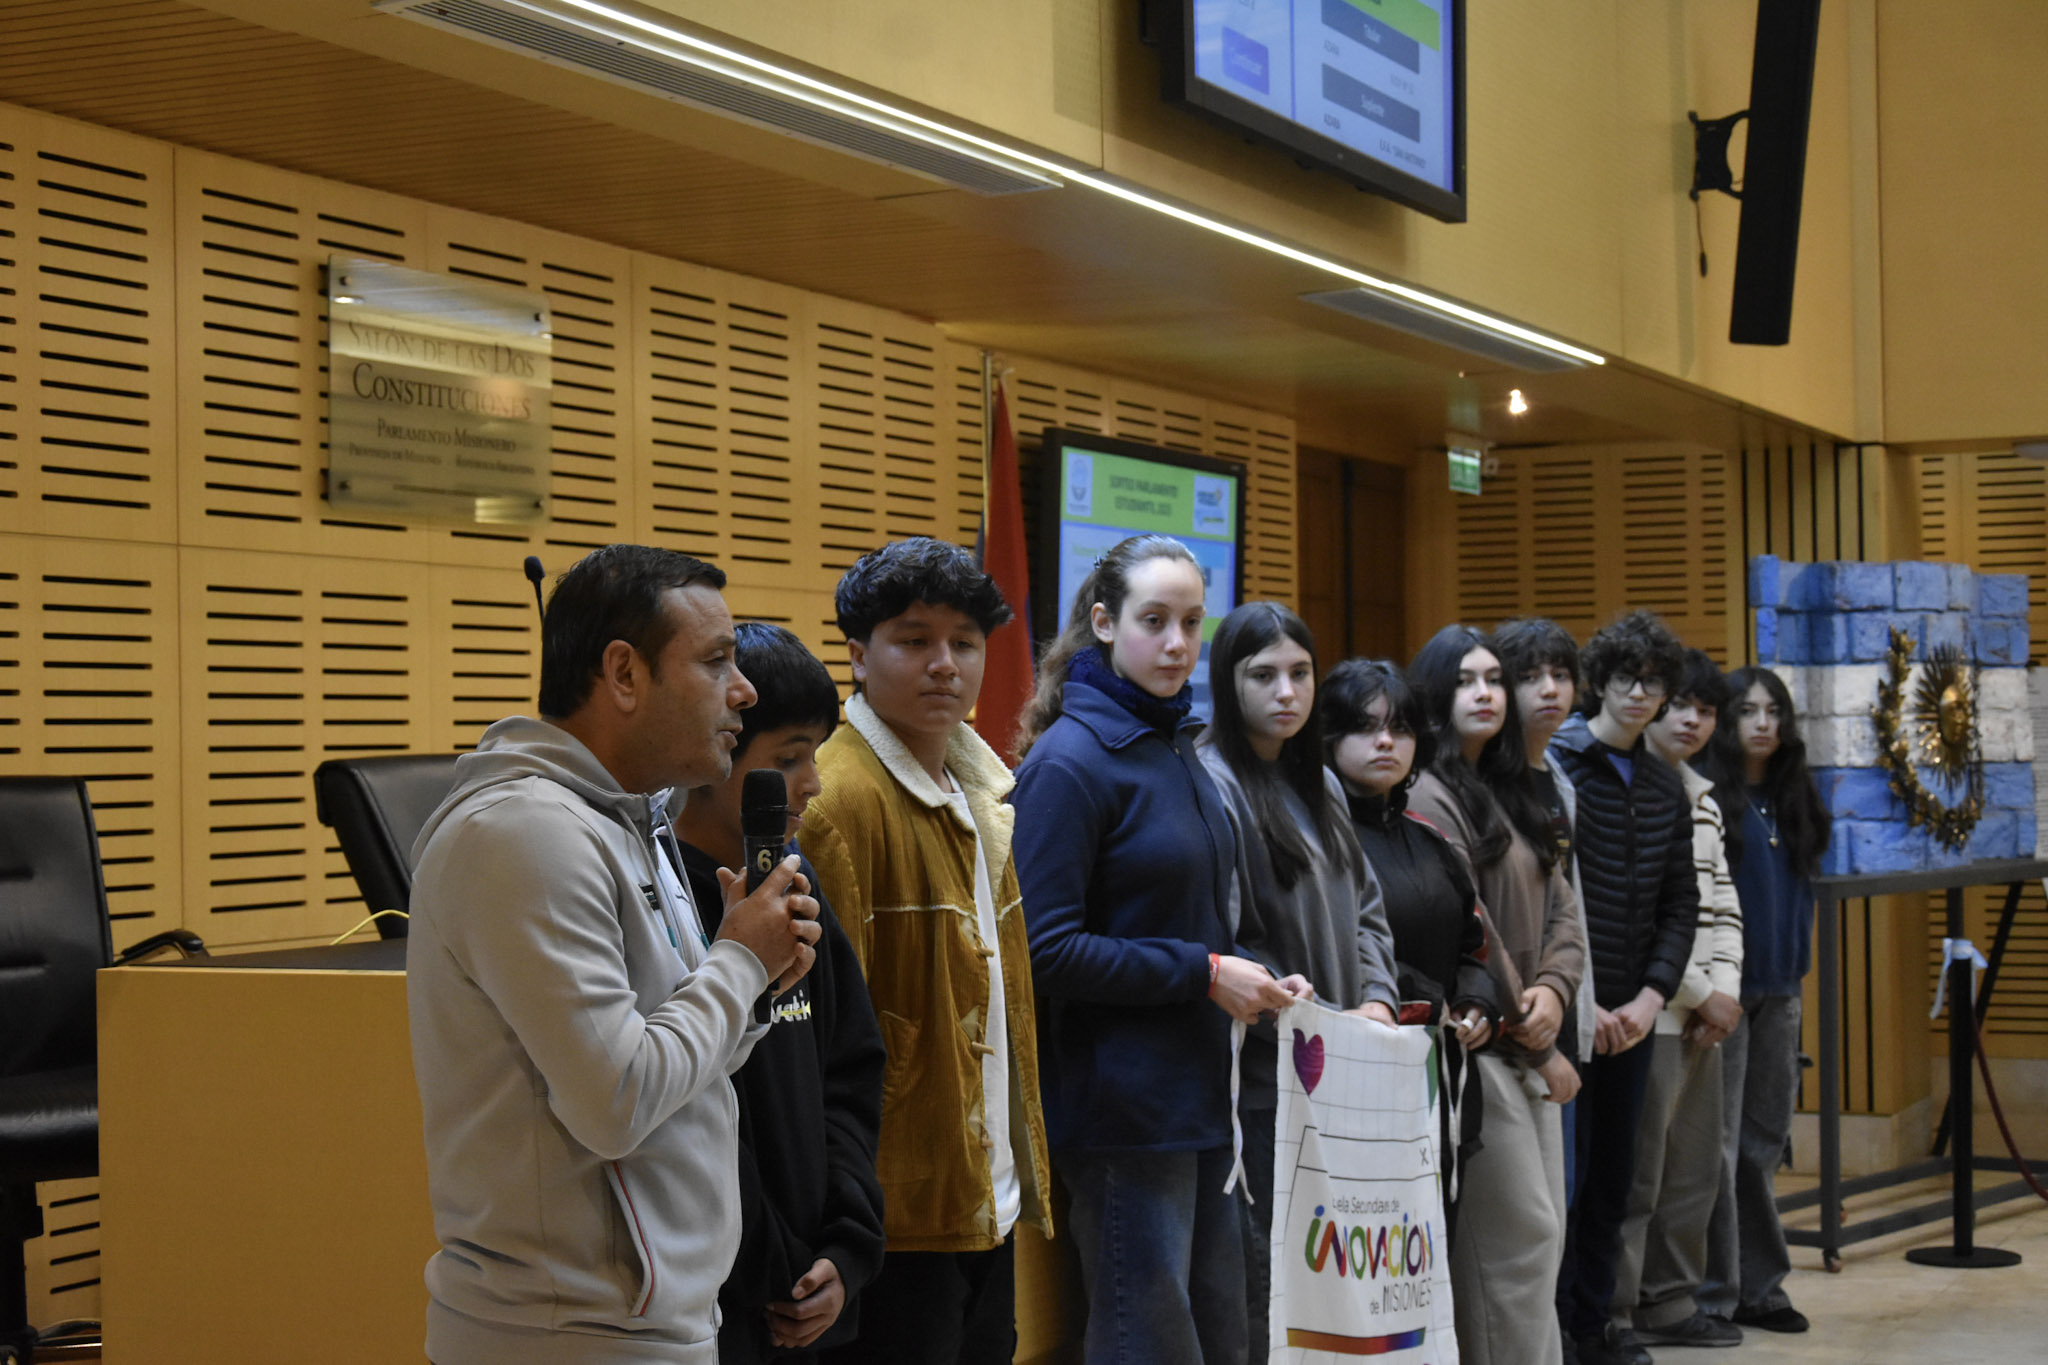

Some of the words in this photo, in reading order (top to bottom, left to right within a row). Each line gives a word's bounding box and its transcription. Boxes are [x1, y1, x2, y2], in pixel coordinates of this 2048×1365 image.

[352, 362, 531, 419] CONSTITUCIONES
[757, 848, 773, 873] 6
[1383, 1277, 1433, 1314] MISIONES
